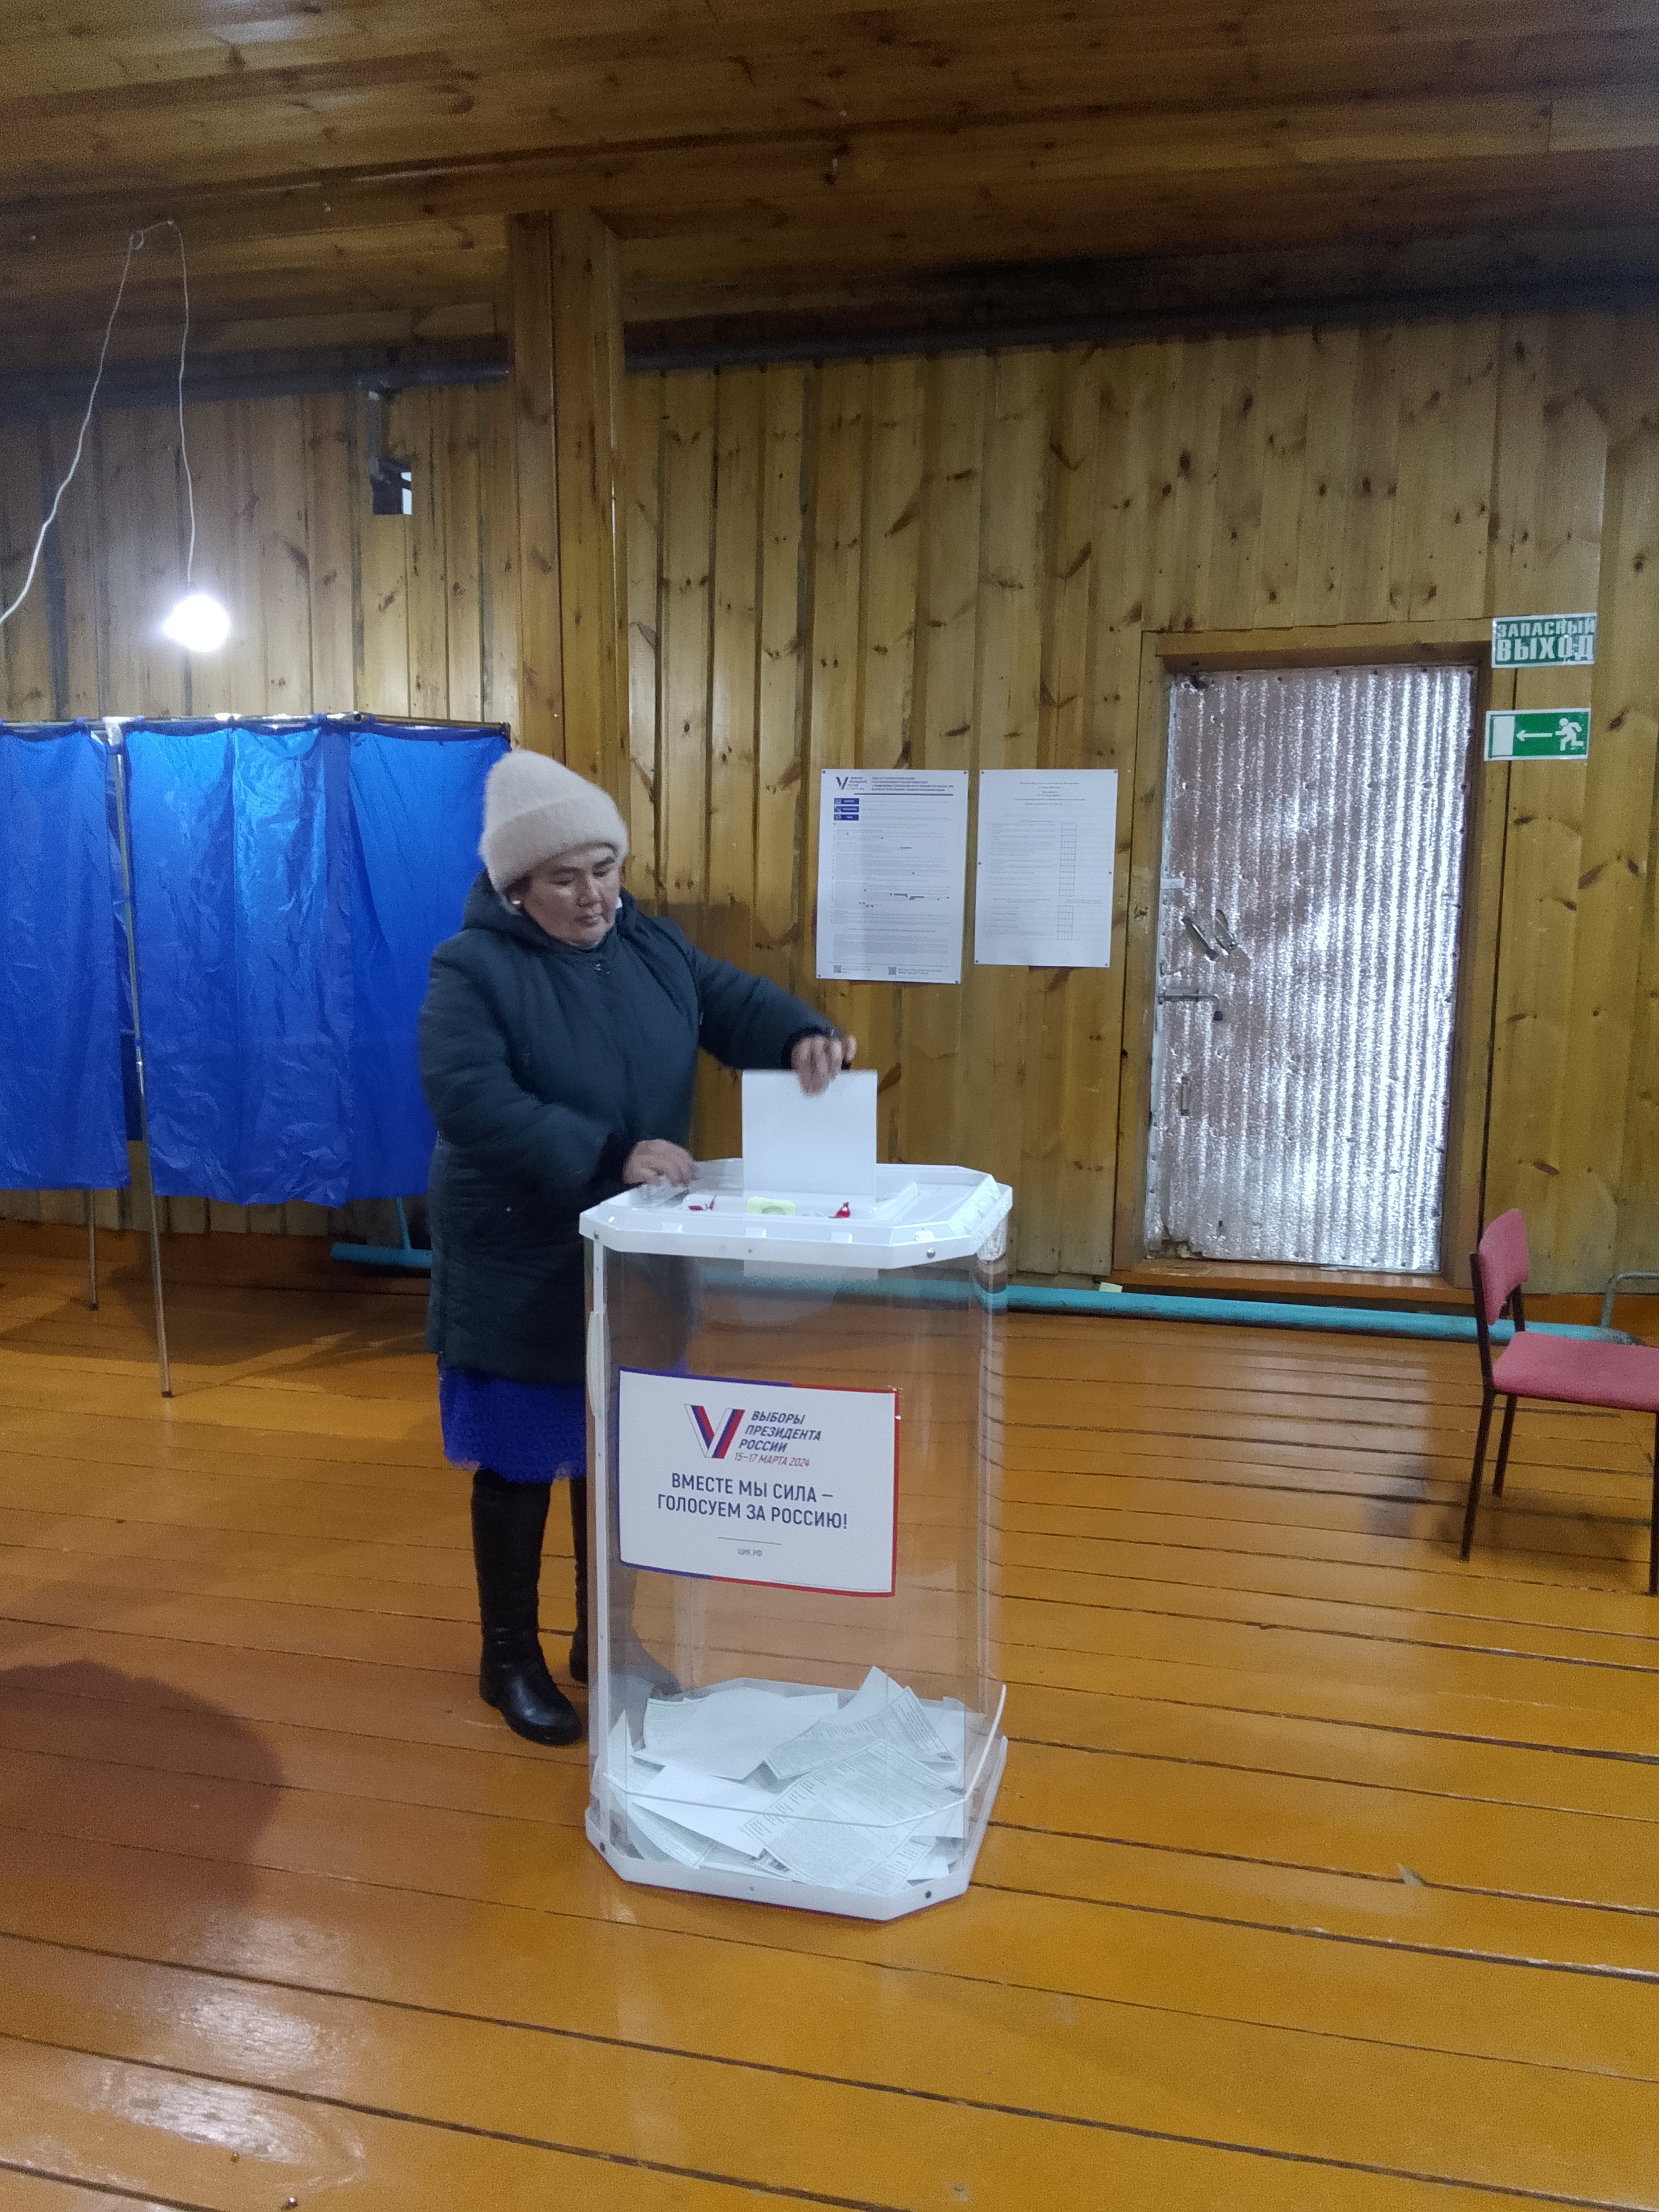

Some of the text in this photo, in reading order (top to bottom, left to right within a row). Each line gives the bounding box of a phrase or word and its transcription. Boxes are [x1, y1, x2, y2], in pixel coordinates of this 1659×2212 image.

[1496, 617, 1595, 638] ЗАПАСНЫЙ
[1496, 634, 1594, 661] ВЫХОД
[752, 1411, 805, 1425] ВЫБОРЫ
[745, 1425, 821, 1441] ПРЕЗИДЕНТА
[739, 1439, 788, 1453] РОССИИ
[758, 1454, 787, 1466] МАРТА
[789, 1457, 810, 1467] 2024
[672, 1473, 733, 1494] ВМЕСТЕ
[739, 1479, 767, 1498] МЫ
[773, 1483, 817, 1502] СИЛА
[657, 1494, 848, 1529] ГОЛОСУЕМ ЗА РОССИЮ!
